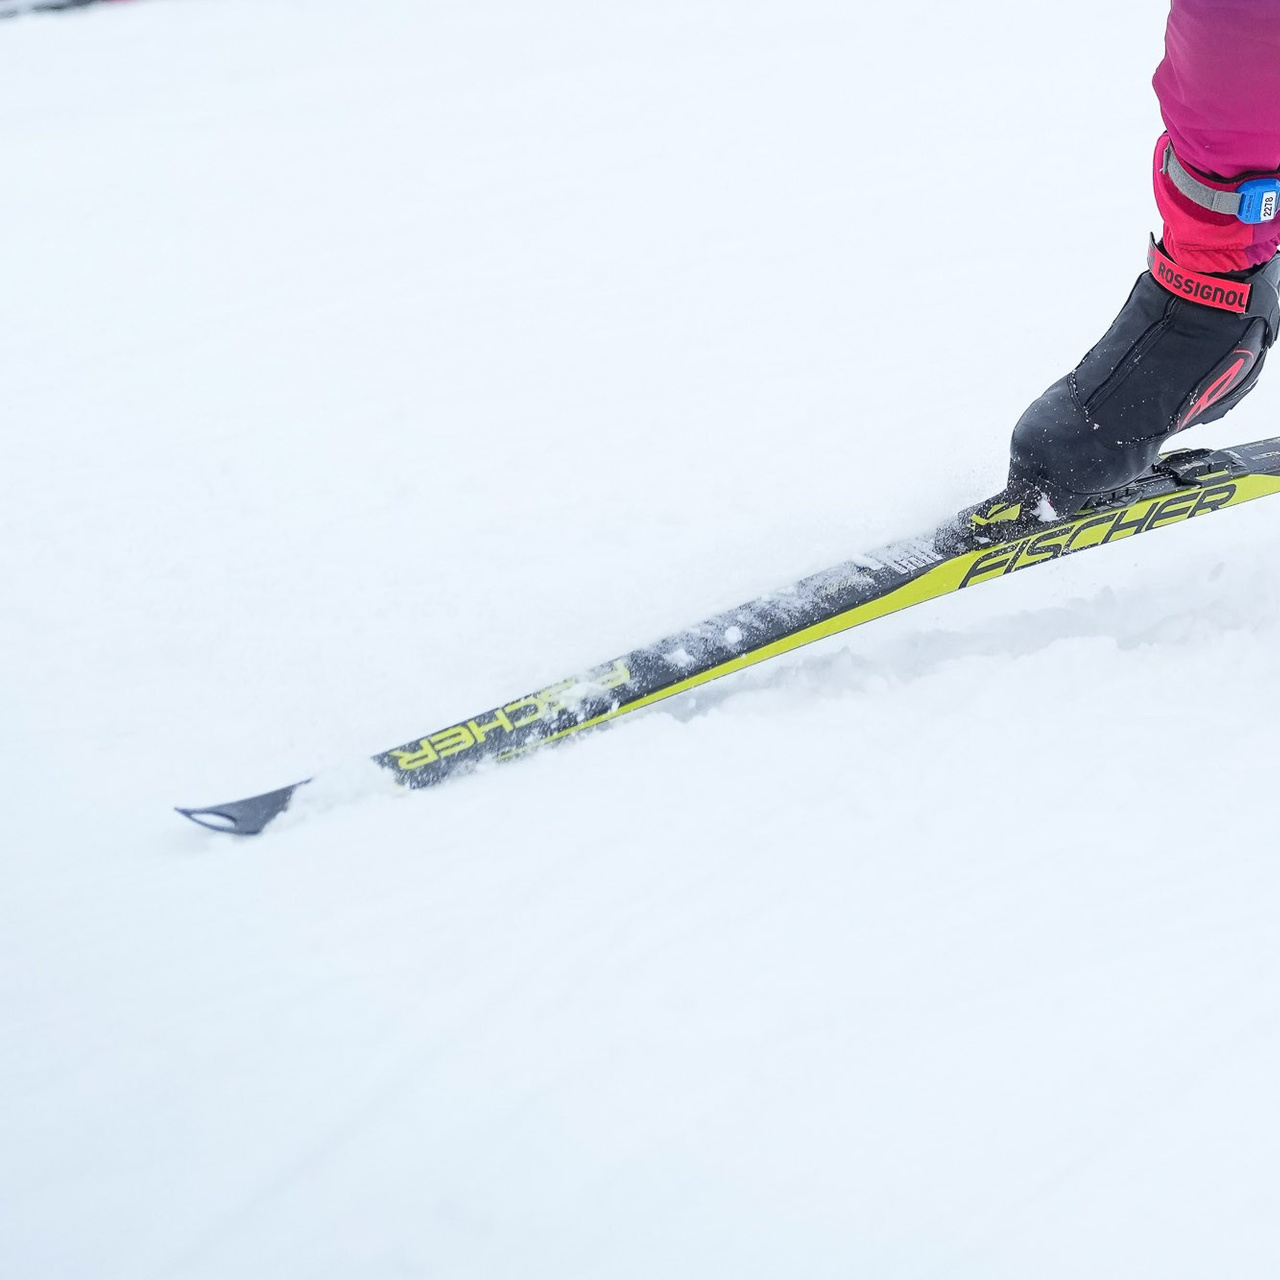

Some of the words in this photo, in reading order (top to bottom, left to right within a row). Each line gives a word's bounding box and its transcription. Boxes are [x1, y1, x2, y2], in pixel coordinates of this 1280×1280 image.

[1263, 196, 1274, 217] 2278
[1157, 262, 1246, 308] ROSSIGNOL
[958, 483, 1237, 590] FISCHER
